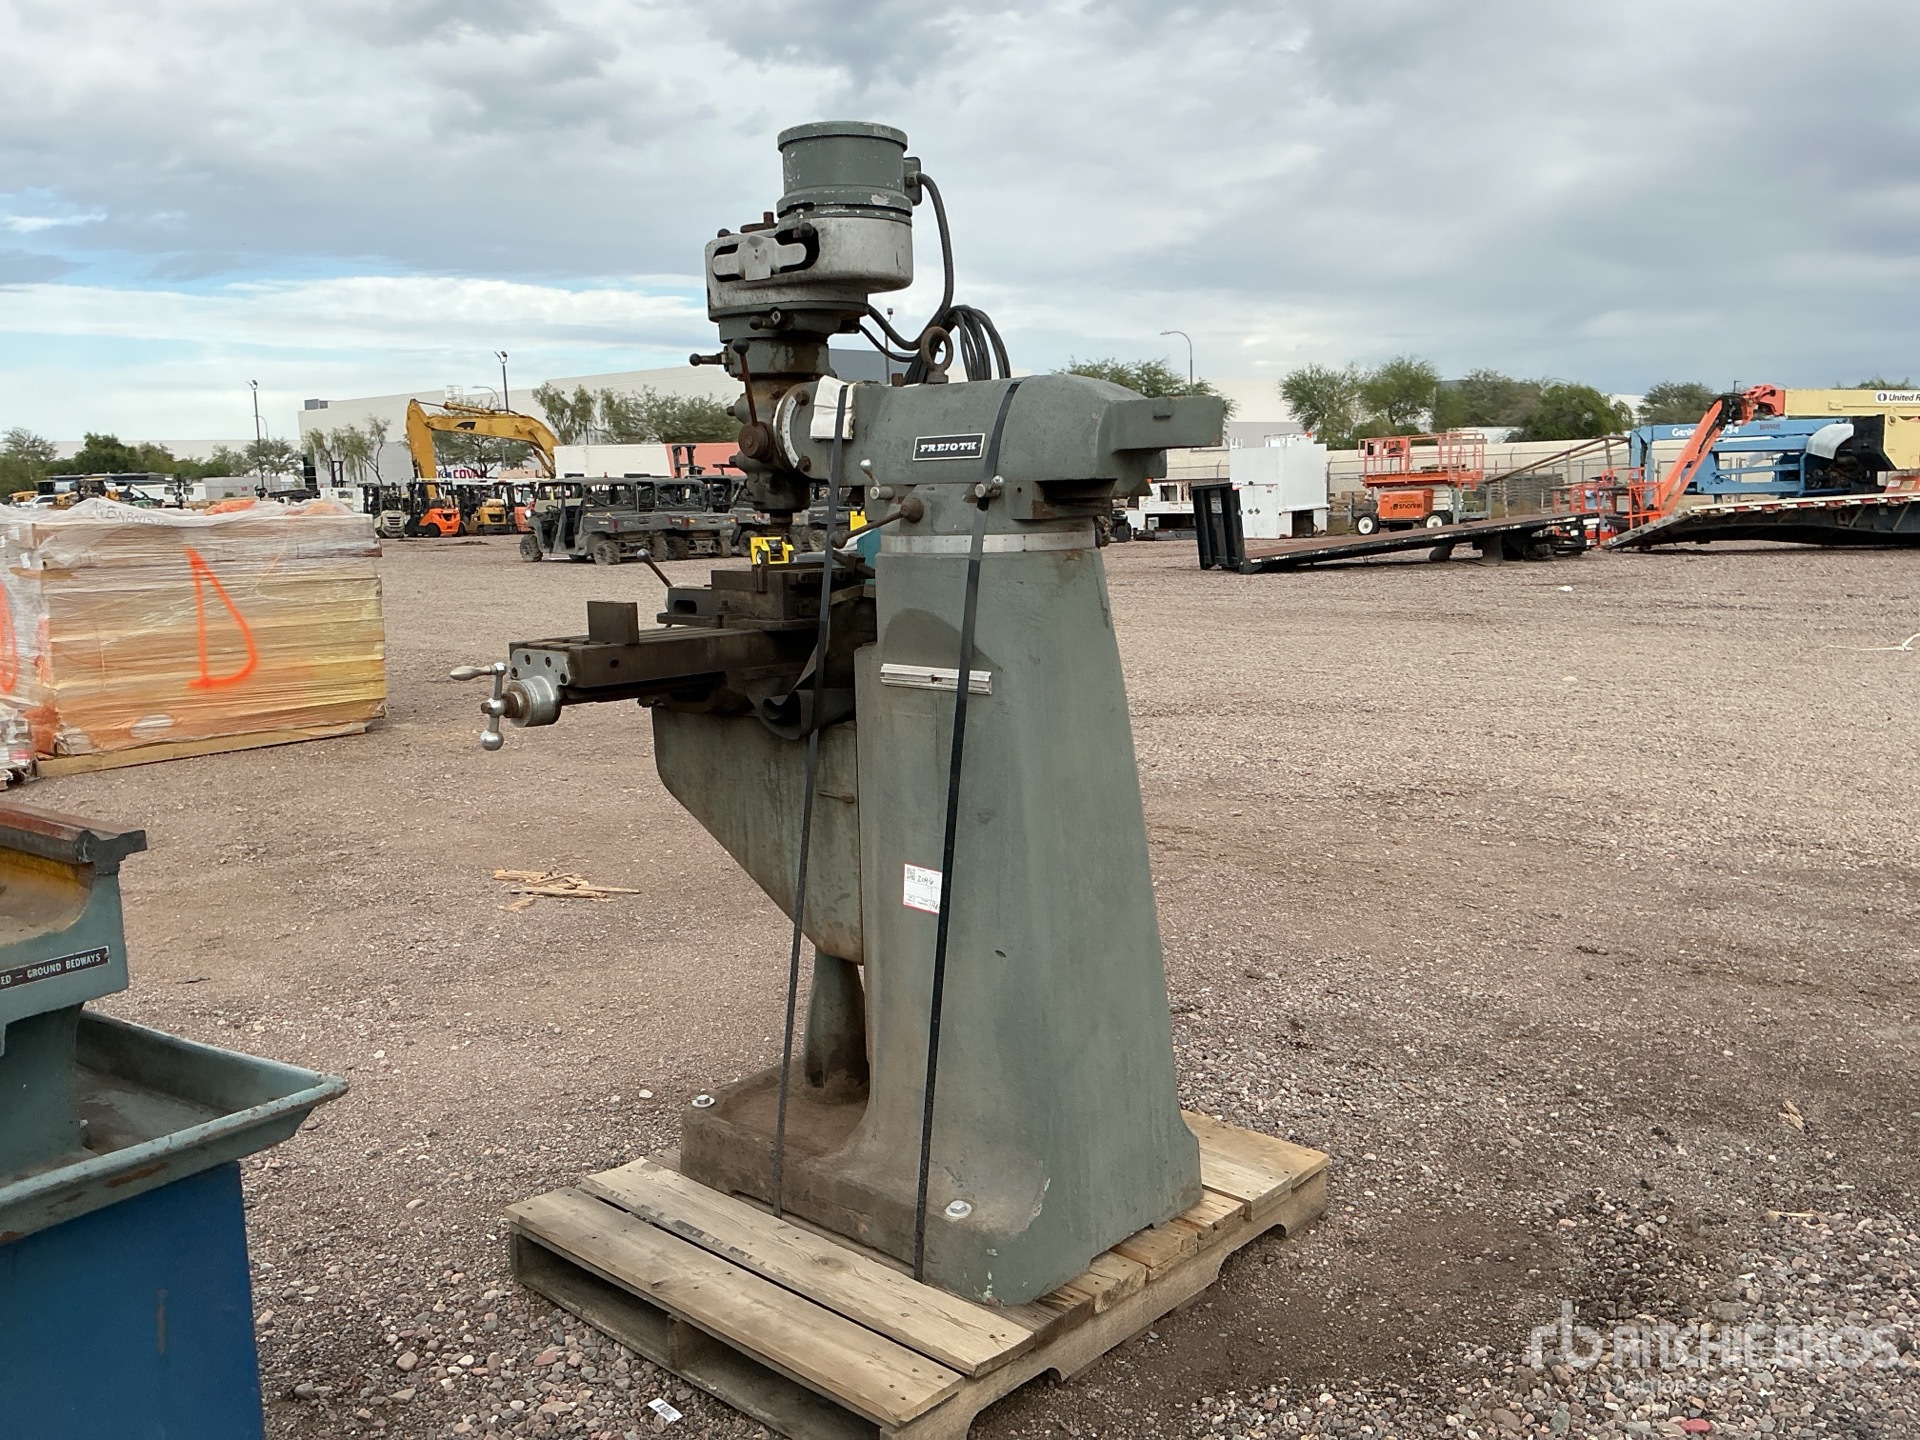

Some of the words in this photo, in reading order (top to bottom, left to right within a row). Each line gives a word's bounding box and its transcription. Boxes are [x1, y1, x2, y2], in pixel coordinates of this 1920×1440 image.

[1889, 393, 1915, 402] United
[919, 442, 977, 453] FREJOTH
[0, 974, 12, 985] ED
[27, 963, 62, 978] GROUND
[65, 953, 101, 969] BEDWAYS
